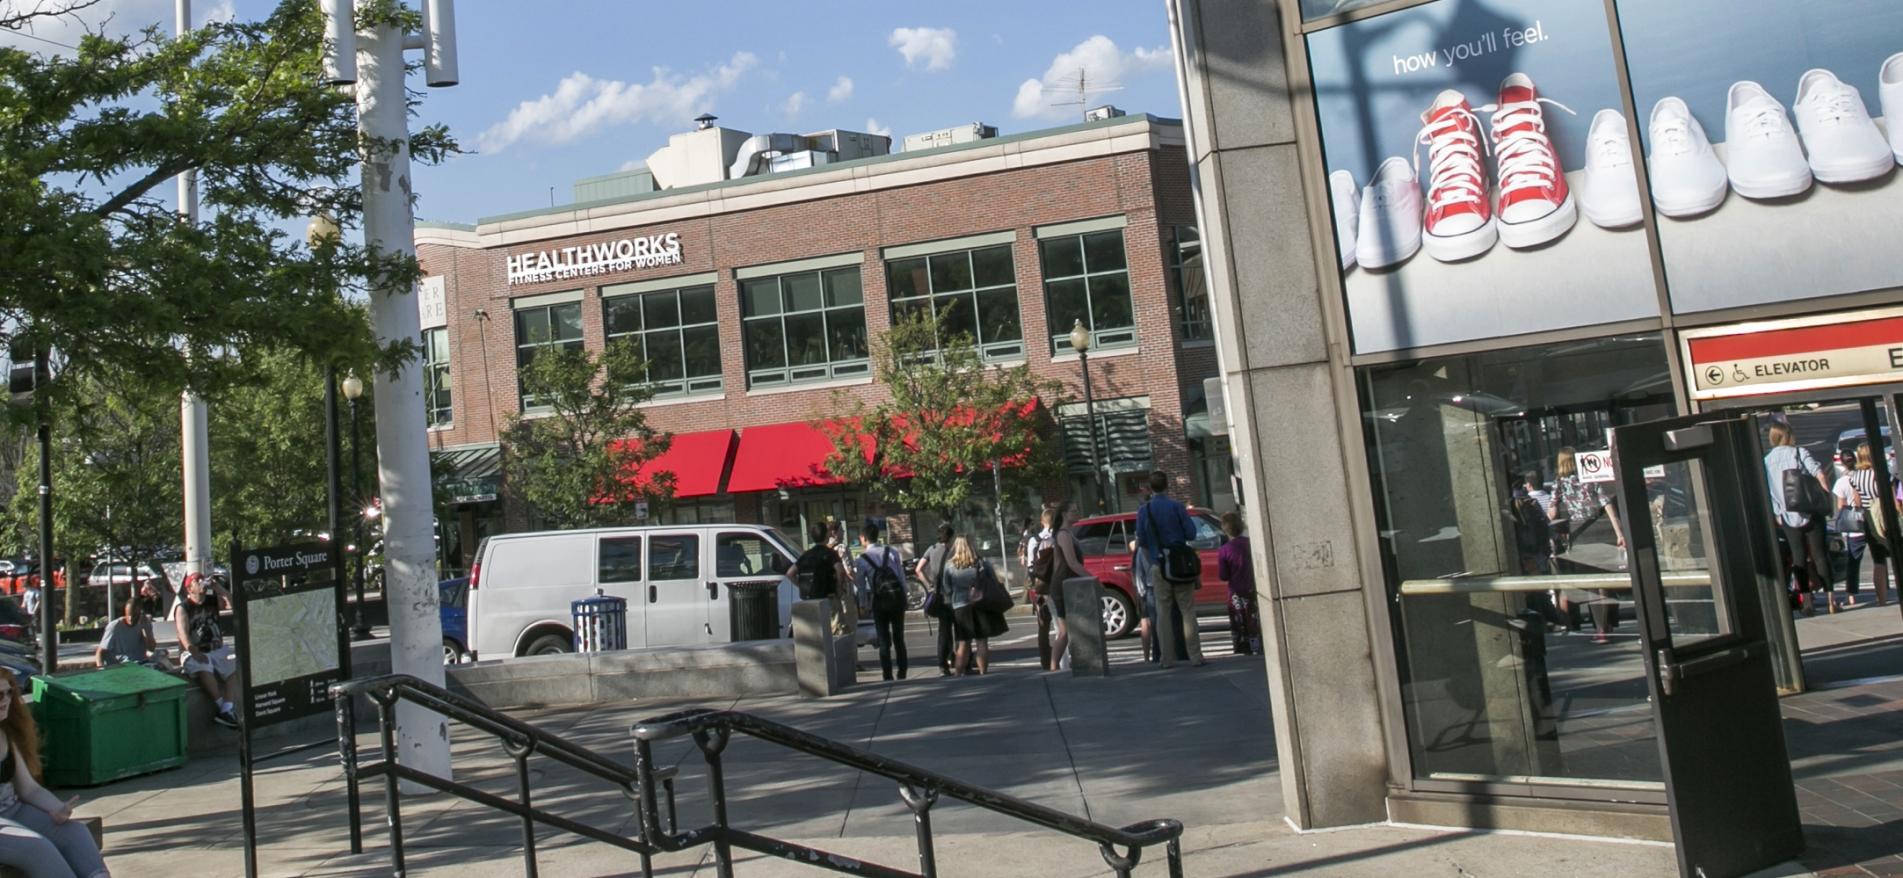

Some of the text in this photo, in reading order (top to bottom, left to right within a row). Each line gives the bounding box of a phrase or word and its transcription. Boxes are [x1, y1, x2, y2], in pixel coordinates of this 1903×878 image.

[1392, 20, 1549, 75] how you'll feel.
[507, 232, 680, 275] HEALTHWORKS
[508, 252, 681, 285] FITNESS CENTERS FOR WOMEN
[1754, 358, 1830, 377] ELEVATOR
[263, 551, 328, 570] Porter Square
